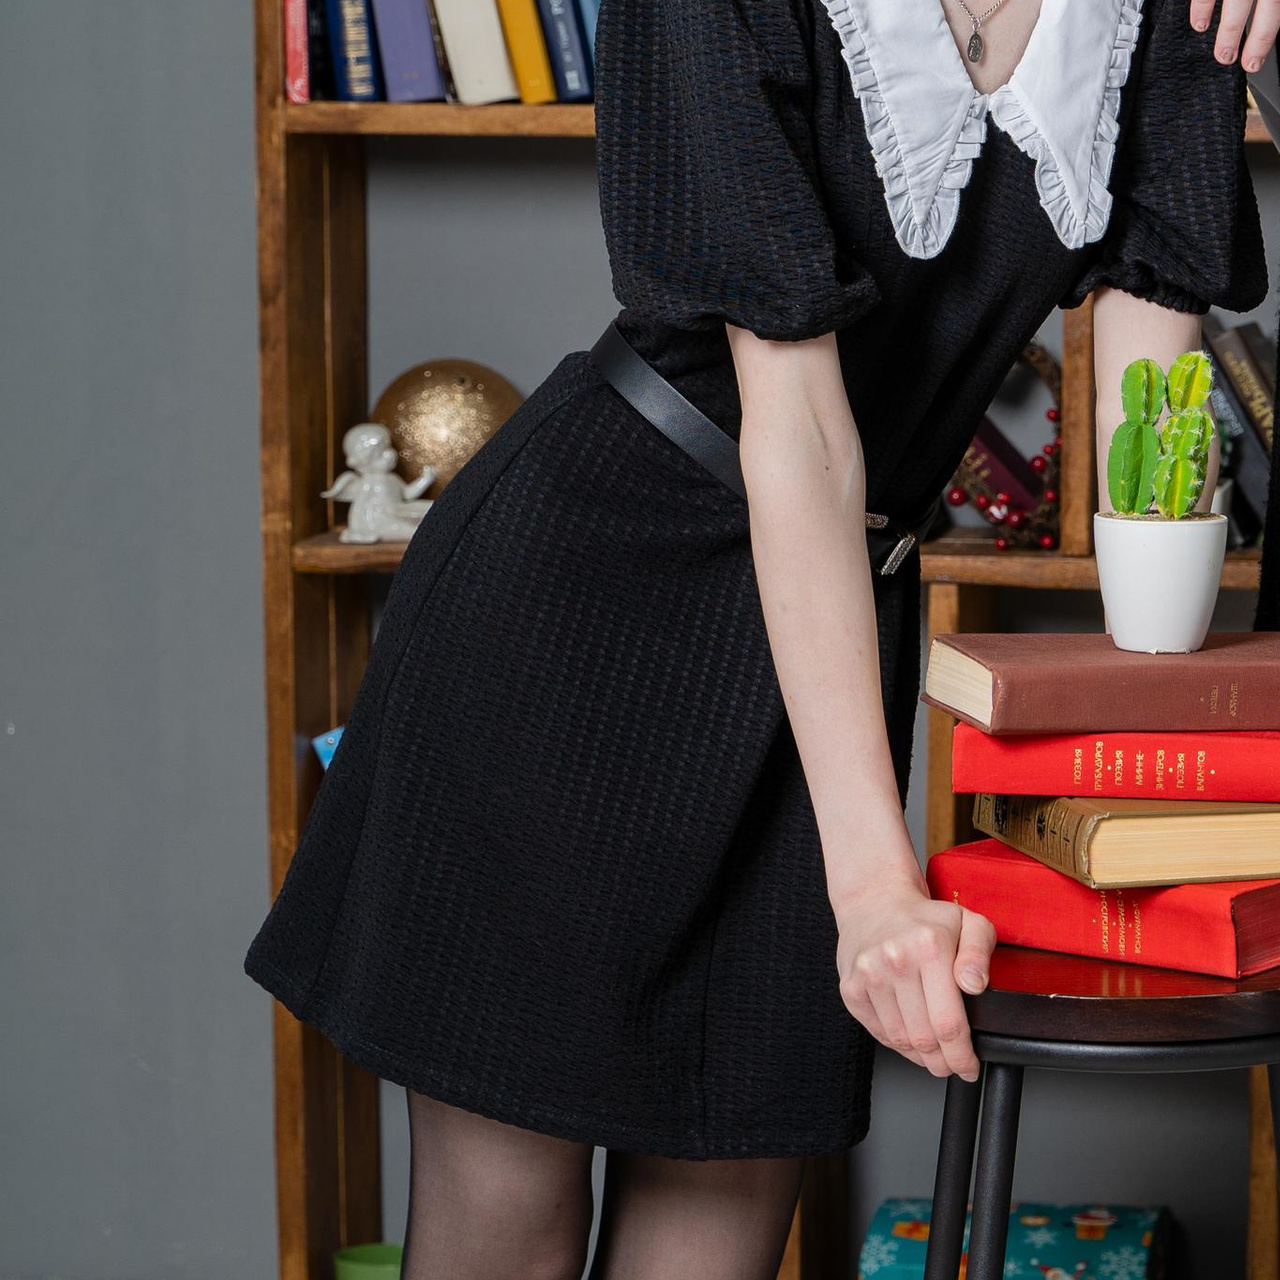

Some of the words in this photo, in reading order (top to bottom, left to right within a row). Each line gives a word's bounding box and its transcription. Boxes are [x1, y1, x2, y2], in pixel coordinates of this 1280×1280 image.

[1074, 748, 1083, 785] ПОЭЗИЯ
[1095, 741, 1104, 791] ТРУБАДУРОВ
[1115, 750, 1124, 786] ПОЭЗИЯ
[1135, 750, 1144, 786] МИННЕ-
[1156, 749, 1165, 791] ЗИНГЕРОВ
[1177, 753, 1185, 789] ПОЭЗИЯ
[1197, 751, 1206, 791] ВАГАНТОВ
